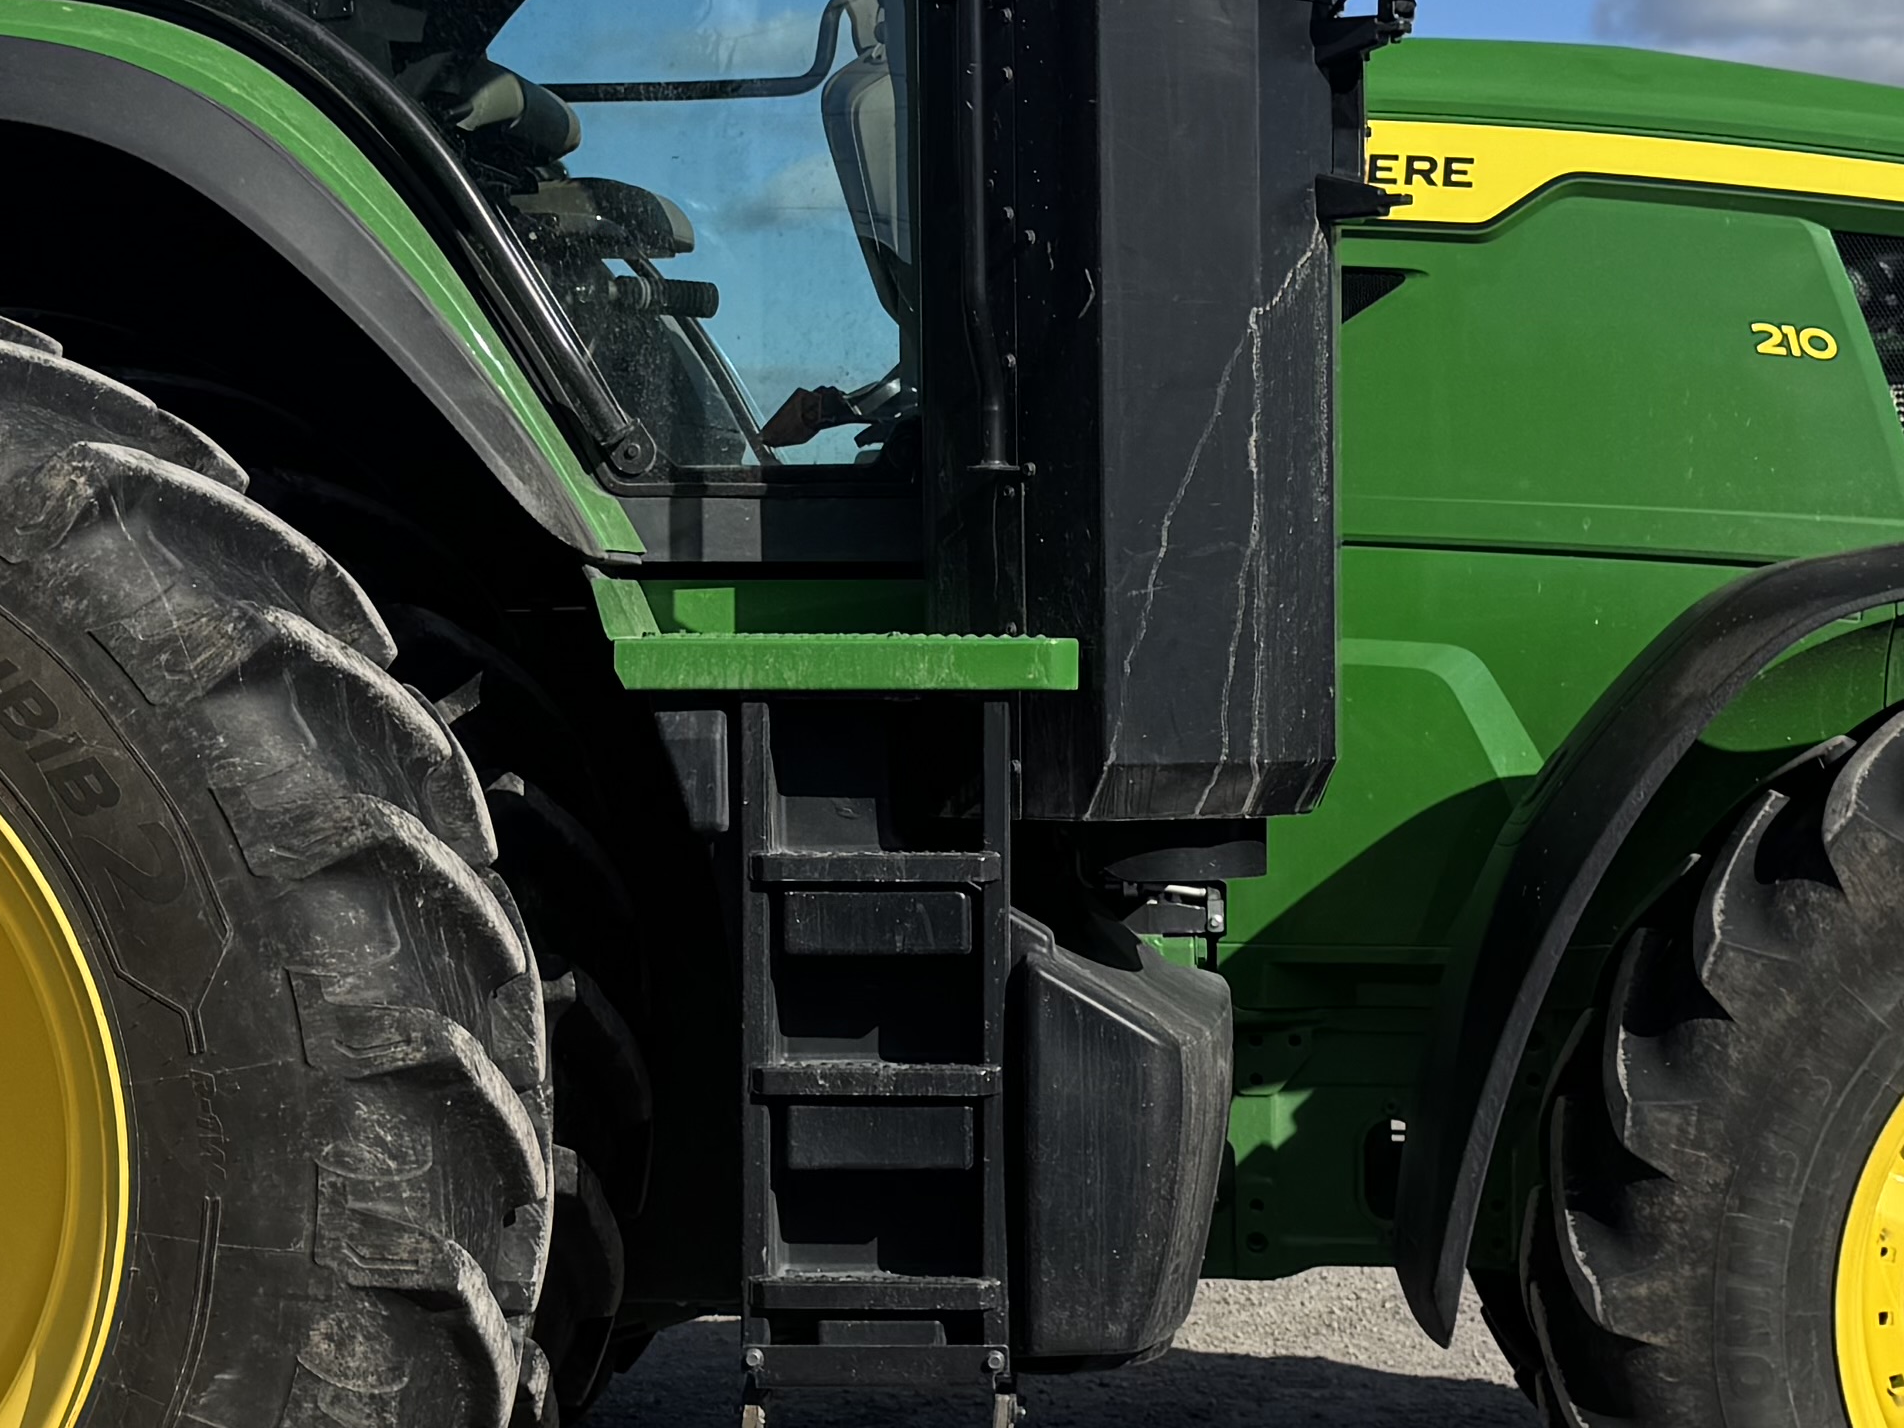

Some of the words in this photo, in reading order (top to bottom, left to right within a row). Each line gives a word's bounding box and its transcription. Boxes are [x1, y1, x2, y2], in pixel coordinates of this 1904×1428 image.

[1368, 153, 1475, 188] ERE
[1750, 322, 1838, 360] 210
[68, 820, 188, 911] 2
